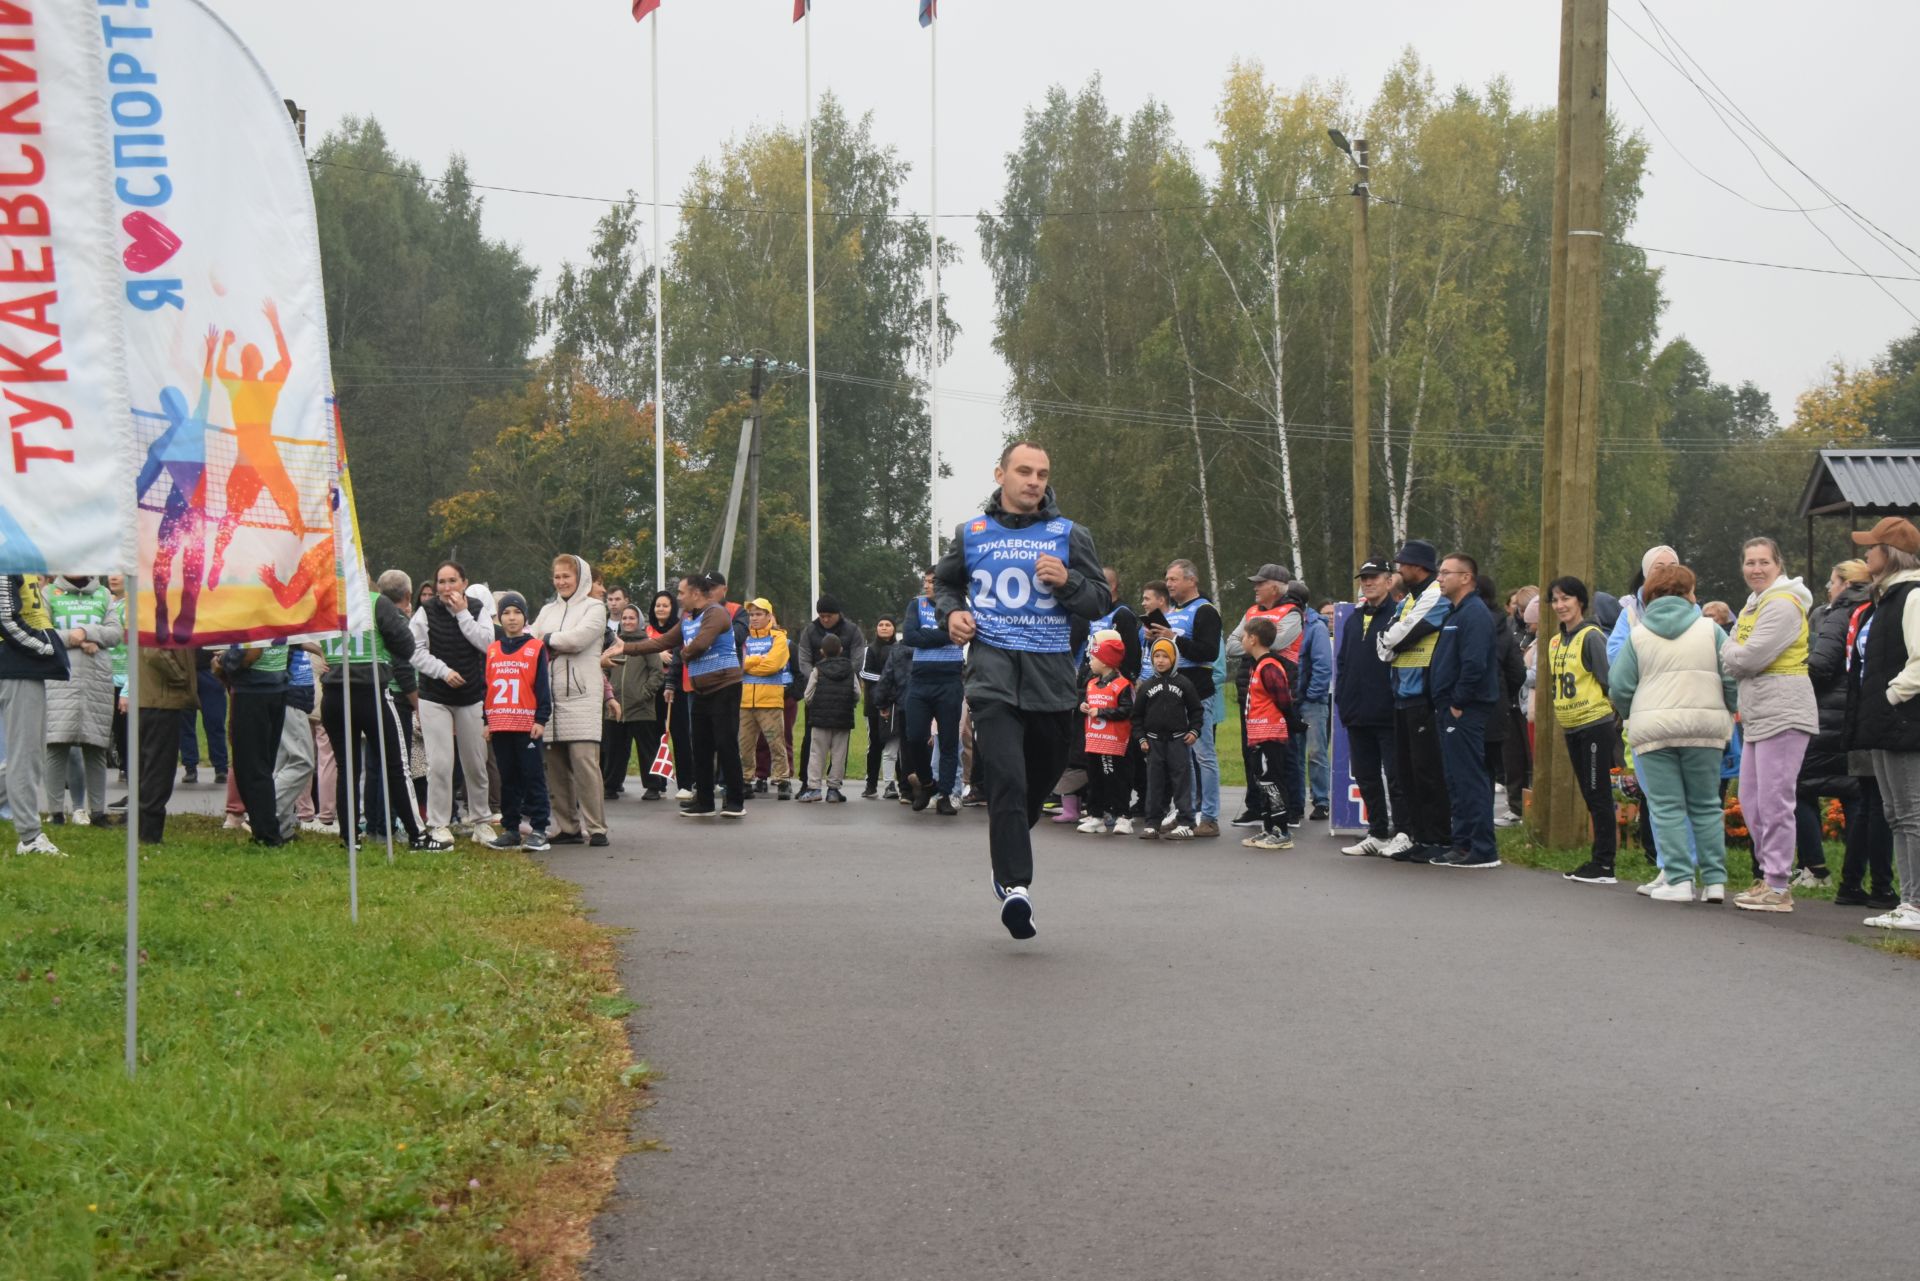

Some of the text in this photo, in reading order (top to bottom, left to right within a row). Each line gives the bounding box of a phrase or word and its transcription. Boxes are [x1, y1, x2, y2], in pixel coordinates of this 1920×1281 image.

[126, 278, 185, 311] Я
[976, 538, 1057, 553] ТУКАЕВСКИЙ
[993, 547, 1037, 560] РАЙОН
[999, 615, 1035, 625] НОРМА
[1036, 615, 1067, 625] ЖИЗНИ
[492, 678, 520, 705] 21
